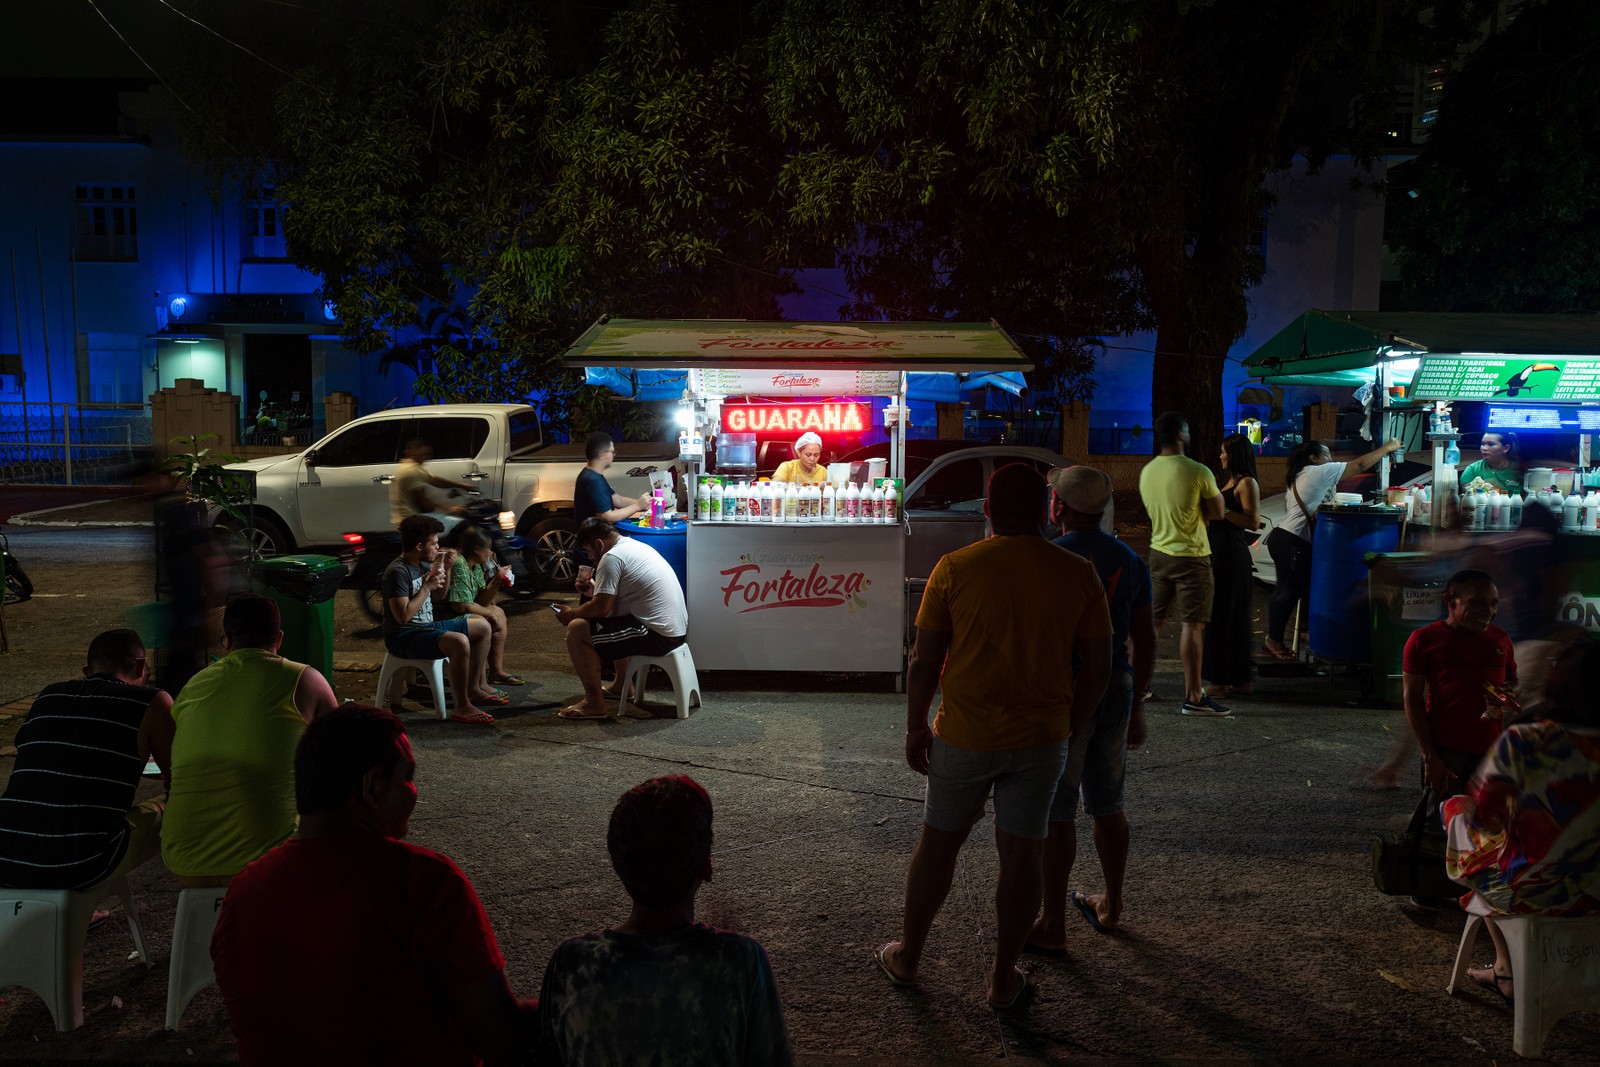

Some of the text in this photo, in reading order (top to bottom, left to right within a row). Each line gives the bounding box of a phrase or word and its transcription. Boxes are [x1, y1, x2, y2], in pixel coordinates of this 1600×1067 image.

[699, 338, 896, 350] Fortaleza
[771, 375, 819, 387] Fortaleza
[720, 563, 865, 607] Fortaleza
[14, 900, 23, 915] F
